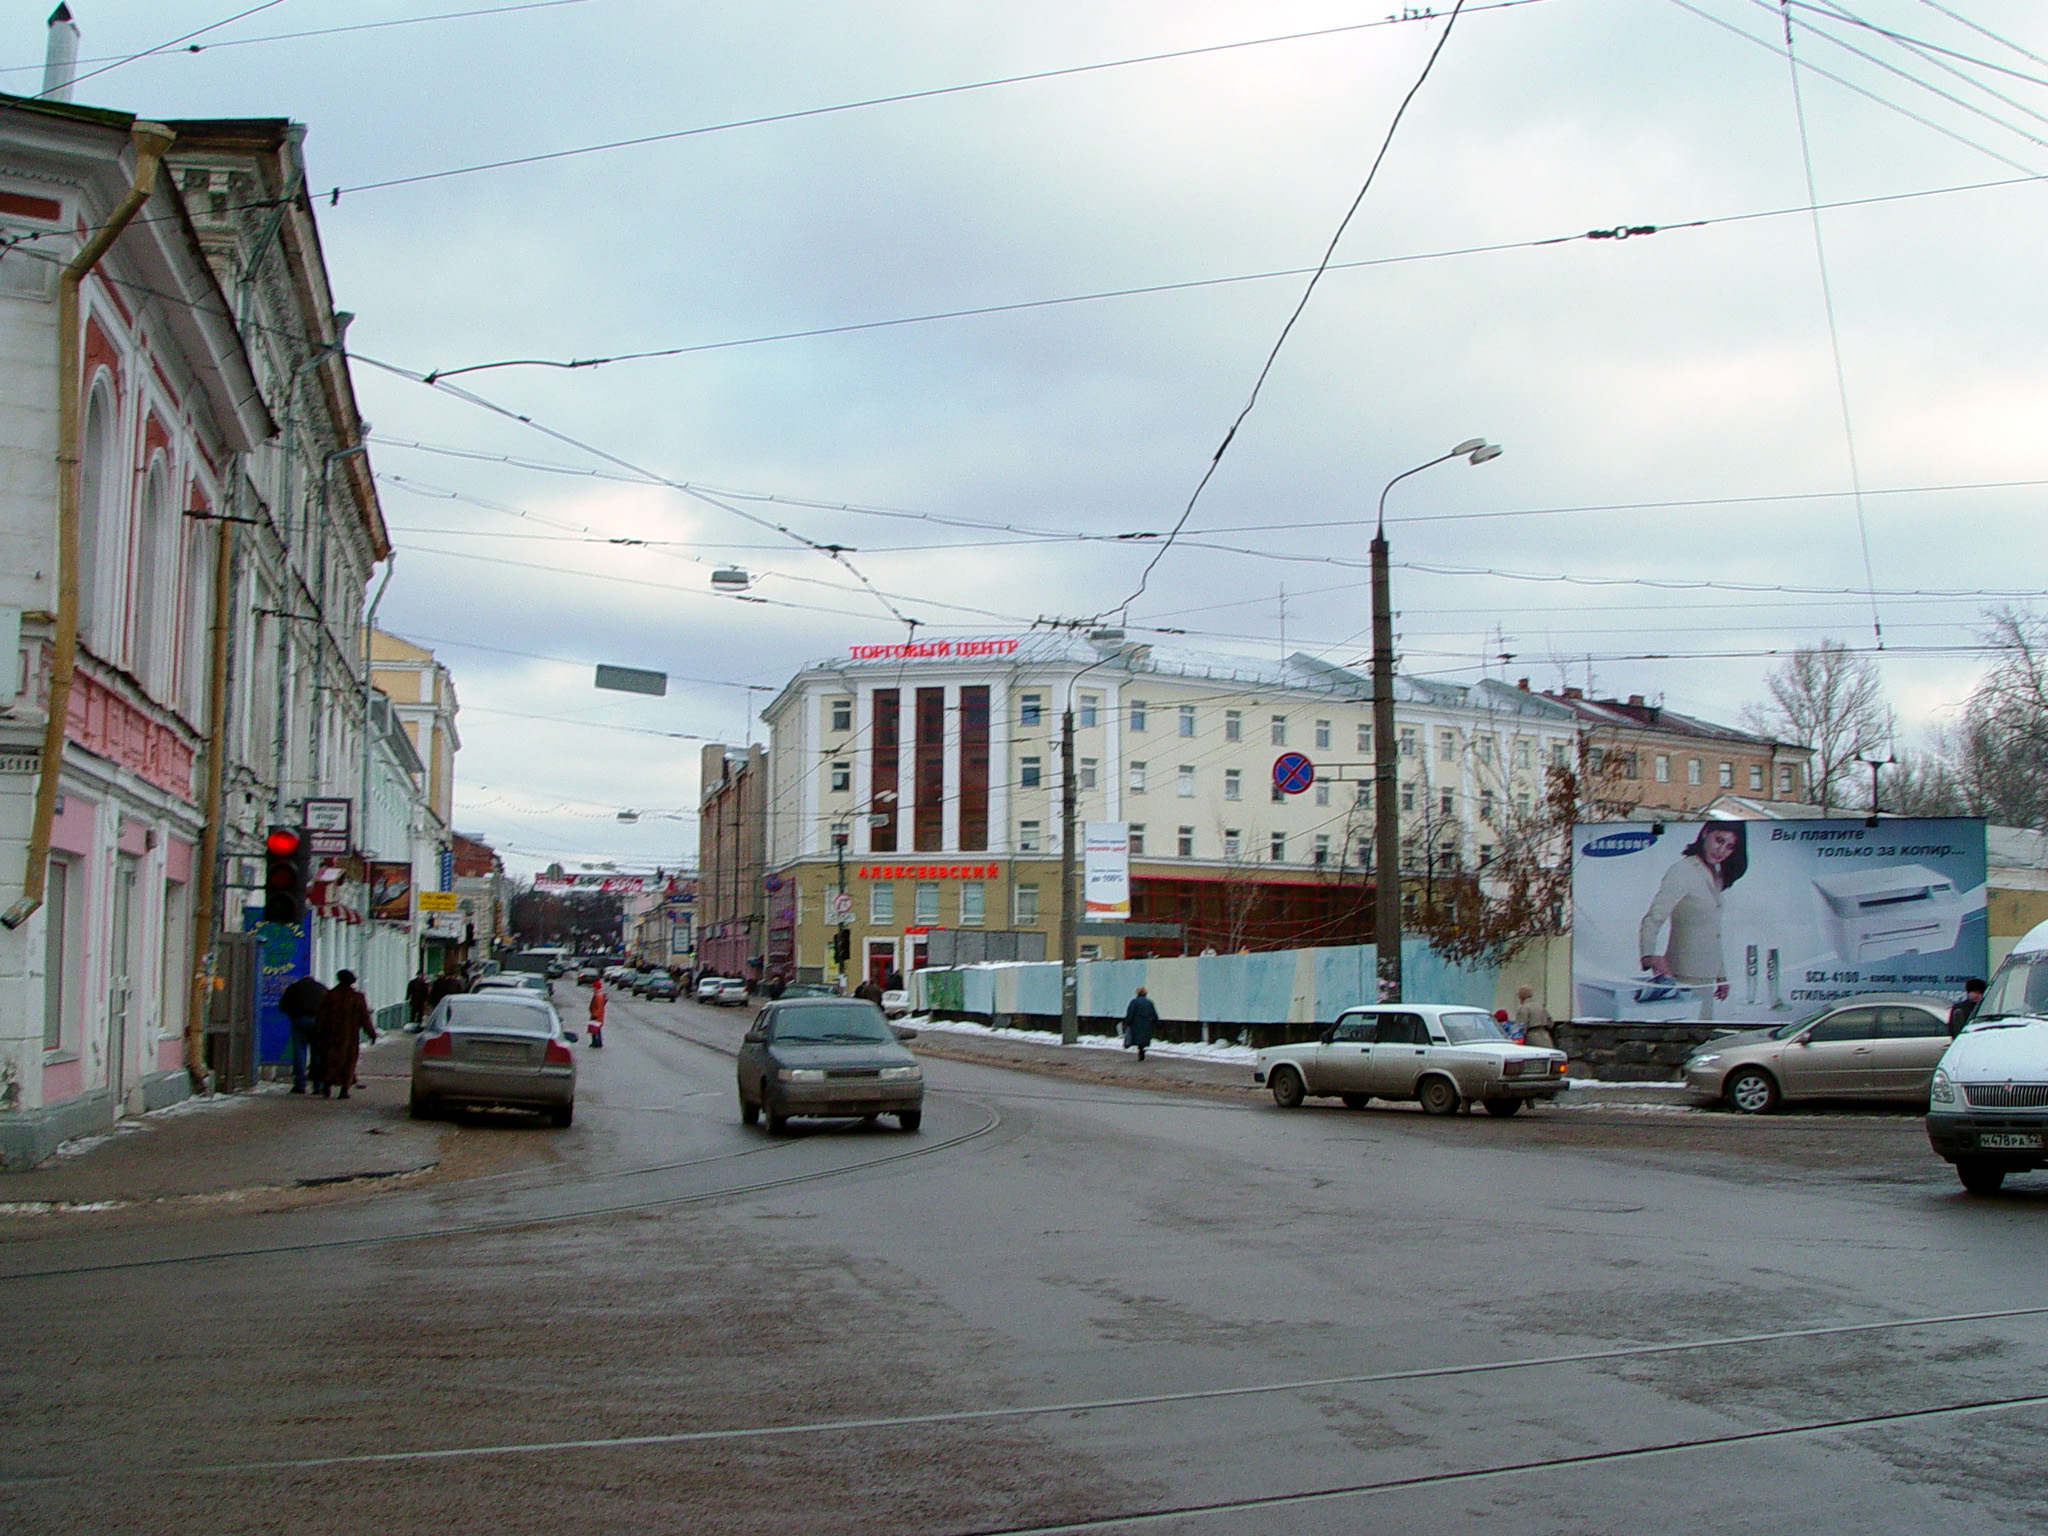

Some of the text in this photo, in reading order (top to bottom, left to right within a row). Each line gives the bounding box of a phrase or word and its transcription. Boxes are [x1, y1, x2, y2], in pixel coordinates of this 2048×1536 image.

[849, 640, 1018, 659] ТОРГОВЫЙ ЦЕНТР
[1771, 828, 1865, 841] Вы платите
[1589, 839, 1650, 851] SAMSUNG
[1816, 846, 1874, 858] только
[1876, 845, 1896, 857] за
[858, 861, 999, 879] АЛЕКСЕЕВСКИЙ
